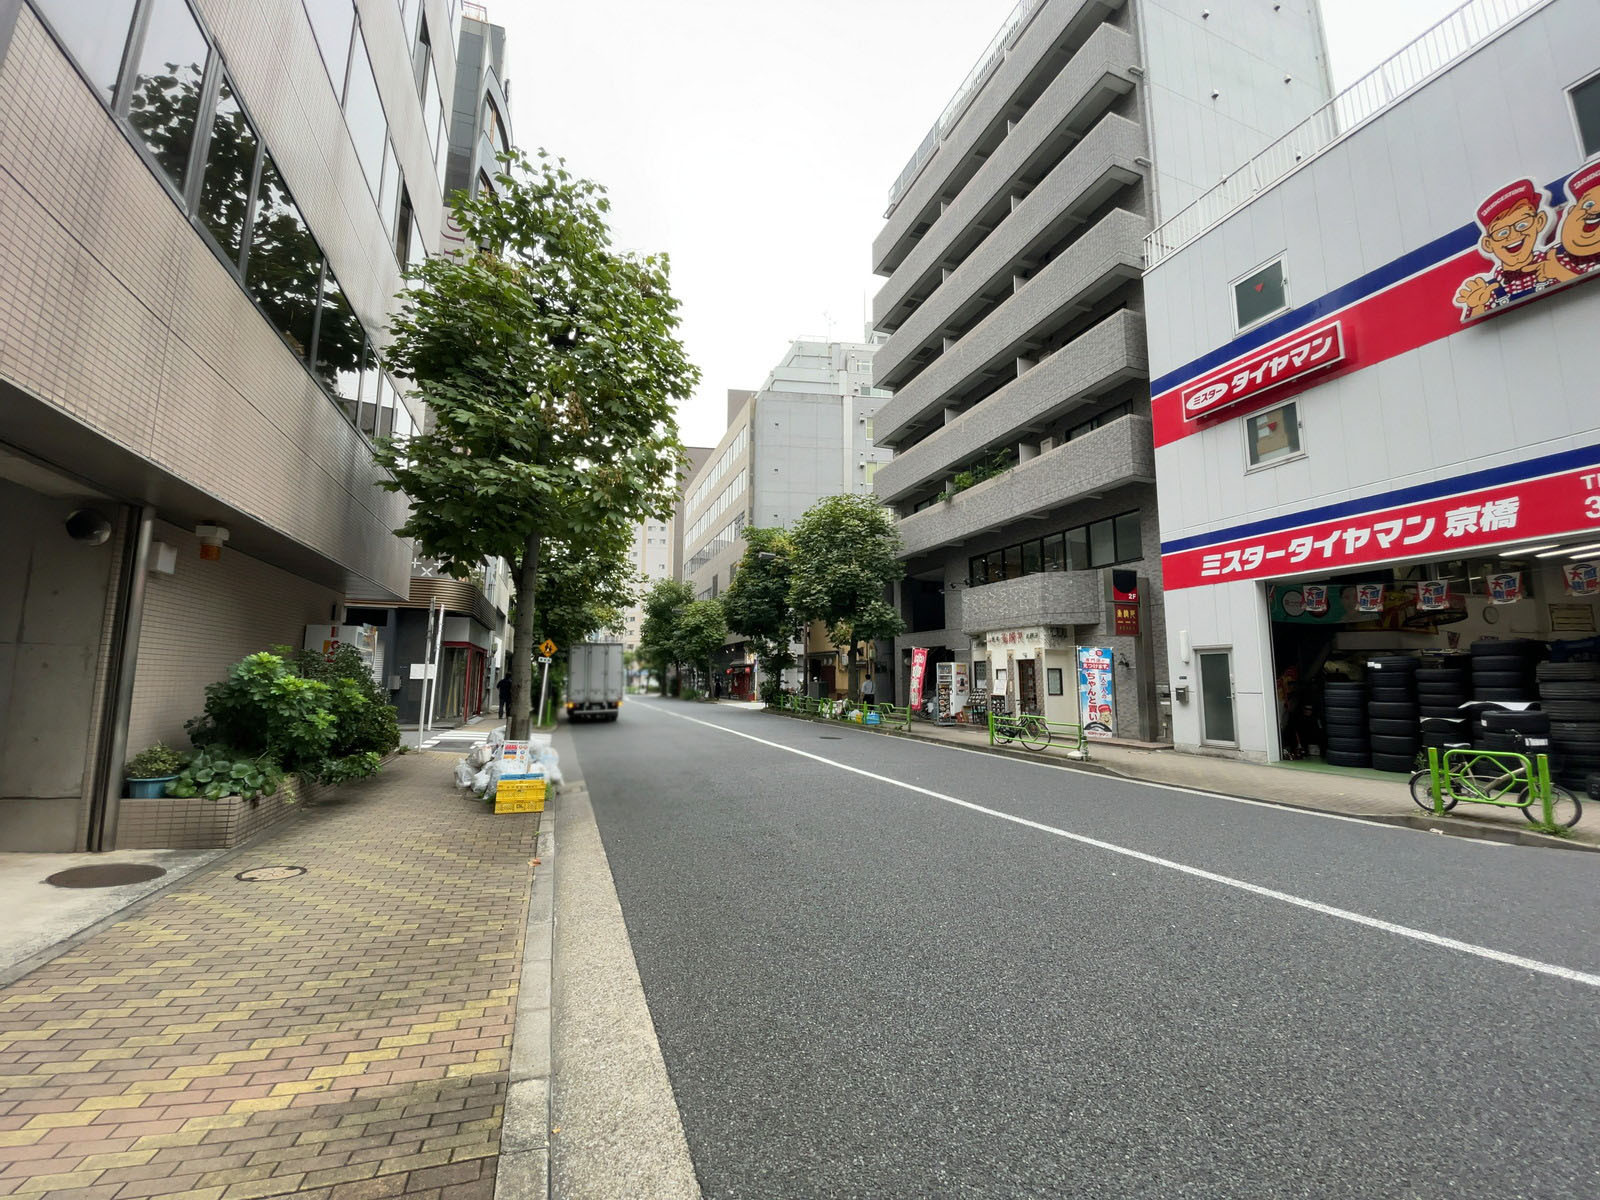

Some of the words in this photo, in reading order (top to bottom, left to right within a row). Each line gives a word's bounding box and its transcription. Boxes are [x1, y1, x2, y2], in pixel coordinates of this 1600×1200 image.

[1193, 387, 1223, 407] ミスター
[1231, 337, 1332, 394] タイヤマン
[1580, 473, 1600, 490] T
[1201, 516, 1435, 577] ミスタータイヤマン
[1444, 496, 1520, 538] 京橋
[1086, 672, 1098, 721] ちゃんと買い
